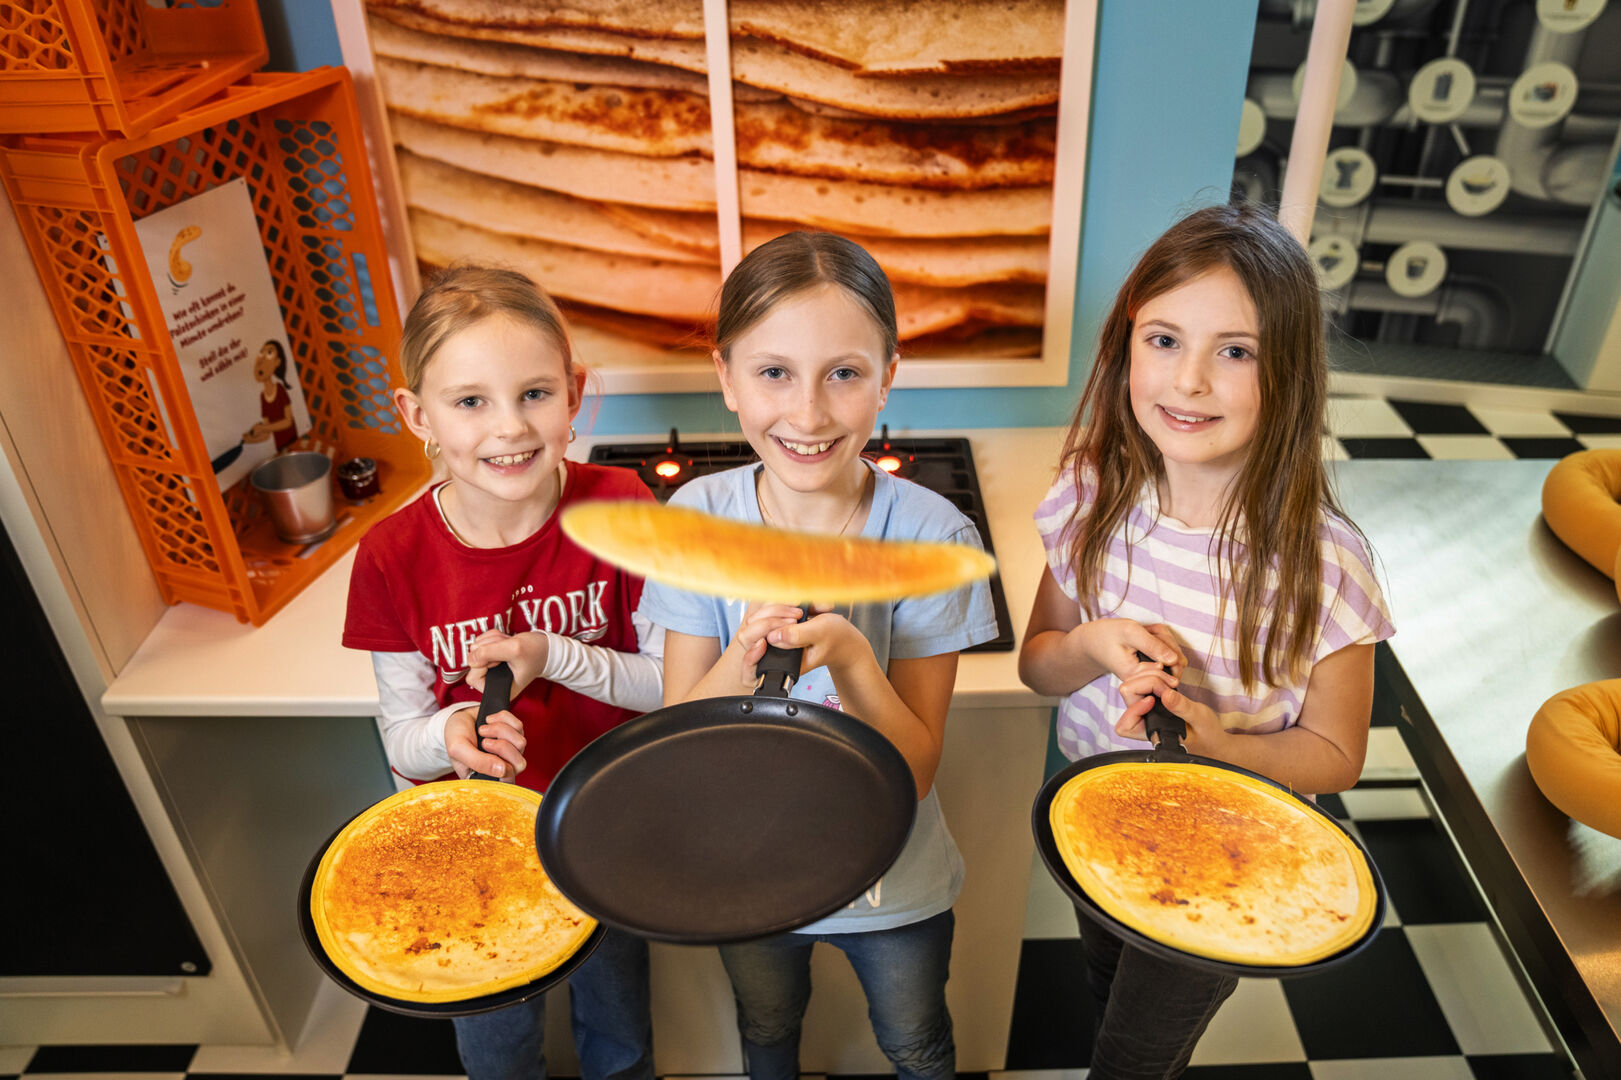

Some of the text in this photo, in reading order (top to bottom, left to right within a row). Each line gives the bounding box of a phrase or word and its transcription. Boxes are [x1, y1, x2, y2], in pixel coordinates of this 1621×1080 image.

[173, 282, 236, 320] Wie oft kannst du
[220, 303, 228, 312] in
[228, 293, 246, 307] einer
[180, 306, 244, 348] Minute umdrehen?
[218, 346, 229, 357] die
[200, 367, 214, 382] und
[518, 580, 608, 635] YORK
